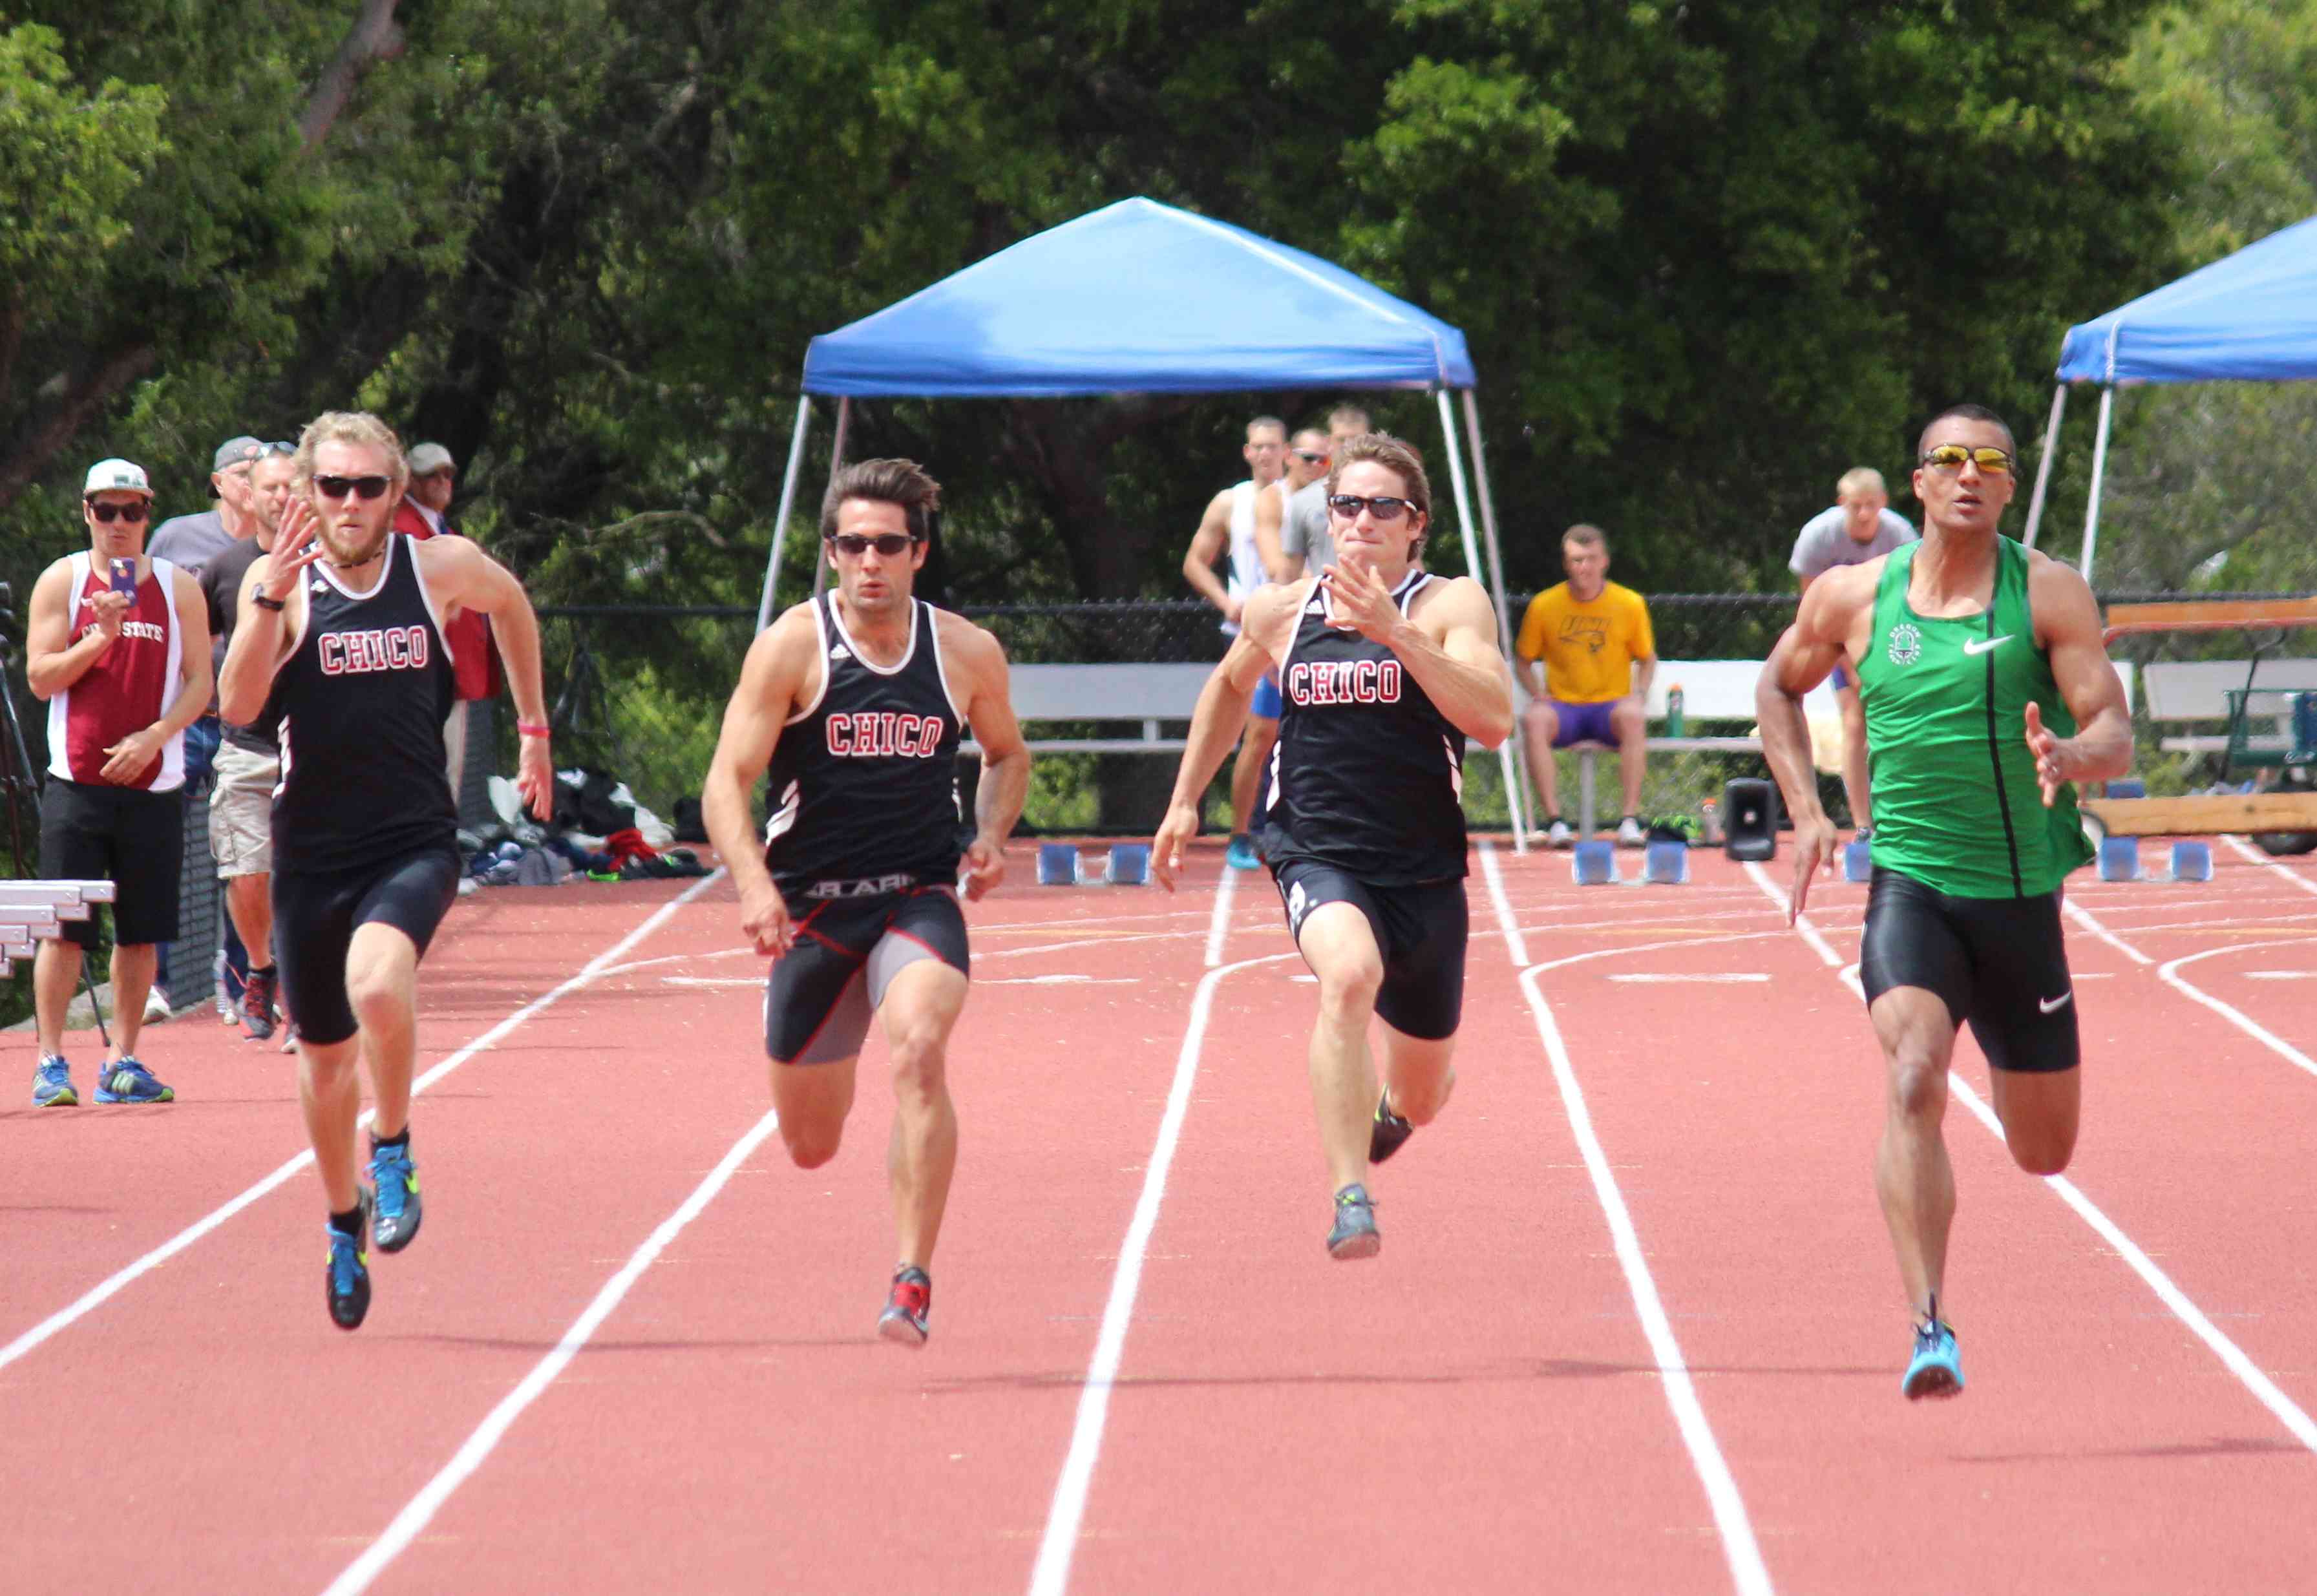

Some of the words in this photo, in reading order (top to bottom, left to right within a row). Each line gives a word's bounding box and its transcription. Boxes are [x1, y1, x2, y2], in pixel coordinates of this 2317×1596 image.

[122, 621, 164, 643] STATE
[318, 625, 428, 675] CHICO
[1289, 660, 1401, 706] CHICO
[825, 713, 944, 758] CHICO
